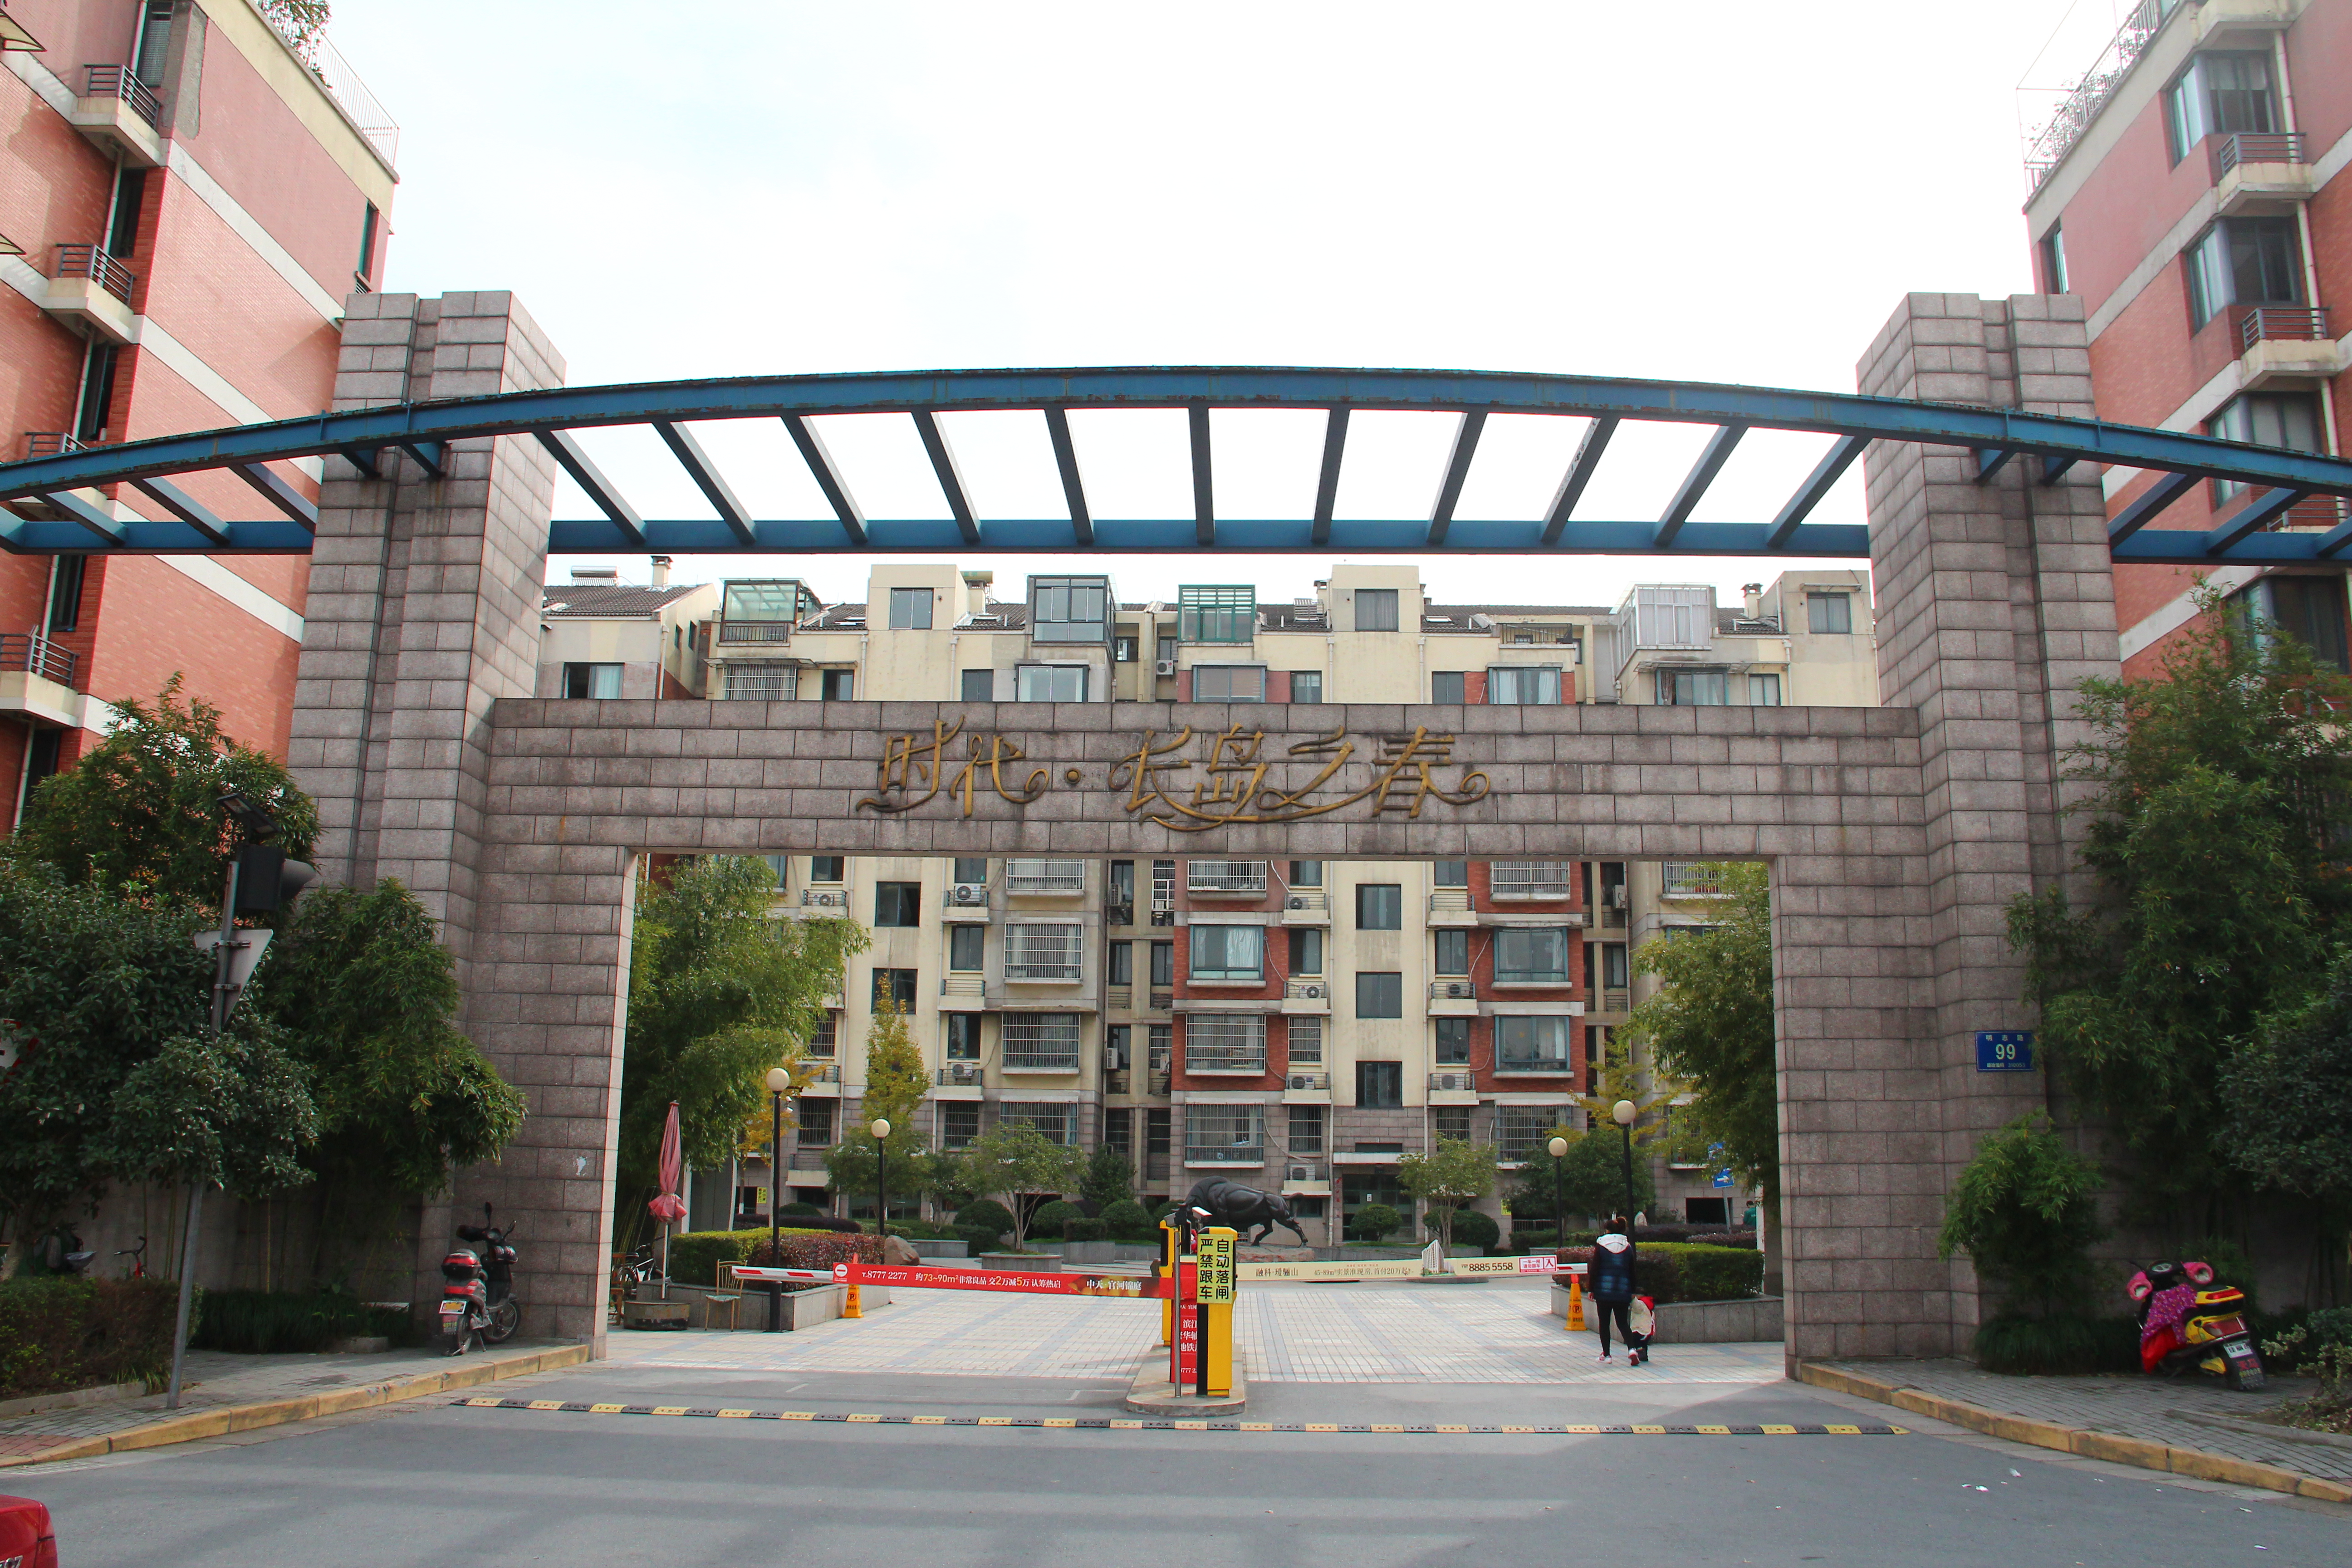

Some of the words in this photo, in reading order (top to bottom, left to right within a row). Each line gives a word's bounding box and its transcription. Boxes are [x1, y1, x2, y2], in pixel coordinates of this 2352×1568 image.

[856, 714, 1490, 831] 时代·长岛之春
[1995, 1044, 2016, 1060] 99
[1199, 1238, 1214, 1299] 严禁跟车
[1216, 1238, 1230, 1299] 自动落闸
[1469, 1263, 1490, 1272] 8885
[1492, 1262, 1513, 1270] 5558
[1545, 1259, 1554, 1268] 入
[888, 1271, 907, 1280] 2277
